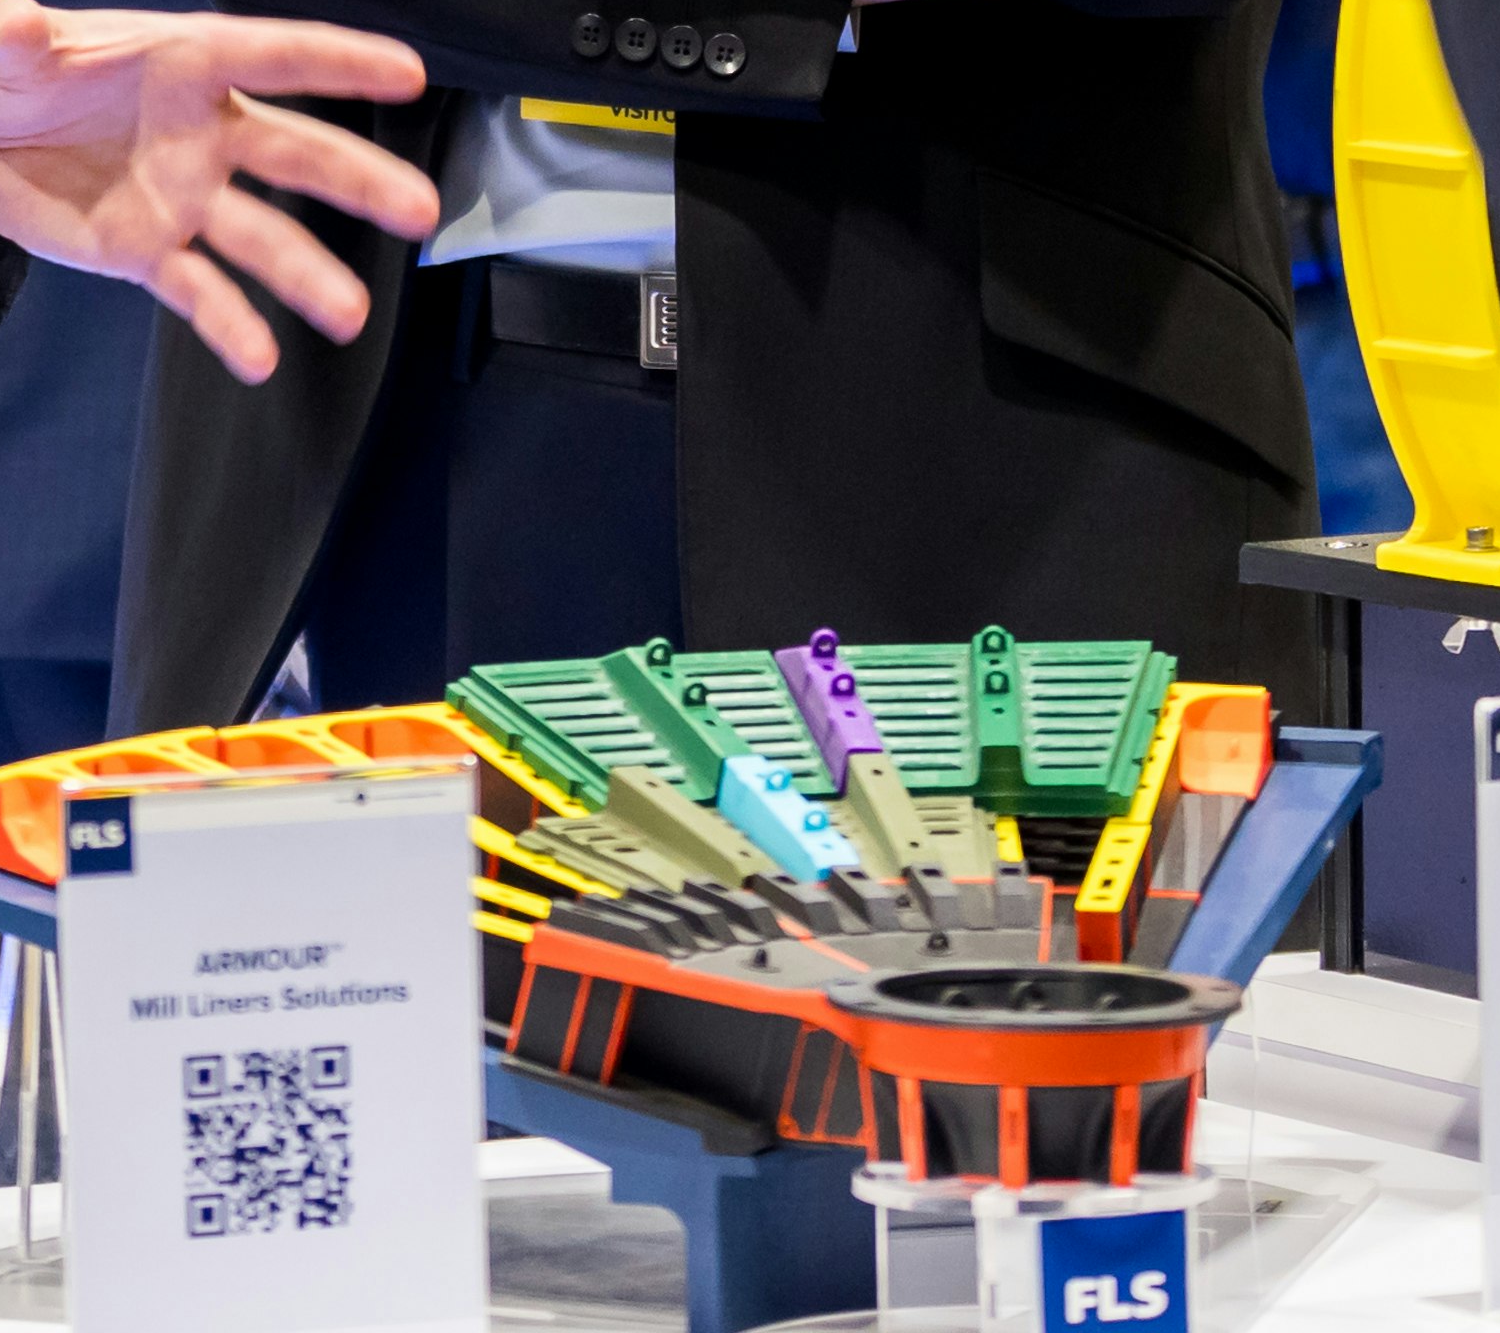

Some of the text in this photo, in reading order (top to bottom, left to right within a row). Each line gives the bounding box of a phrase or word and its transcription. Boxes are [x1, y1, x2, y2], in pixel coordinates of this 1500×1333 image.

[611, 105, 675, 123] VISITO
[69, 819, 126, 850] FLS
[131, 983, 412, 1021] Mill Liners Solutions
[1063, 1269, 1169, 1324] FLS
